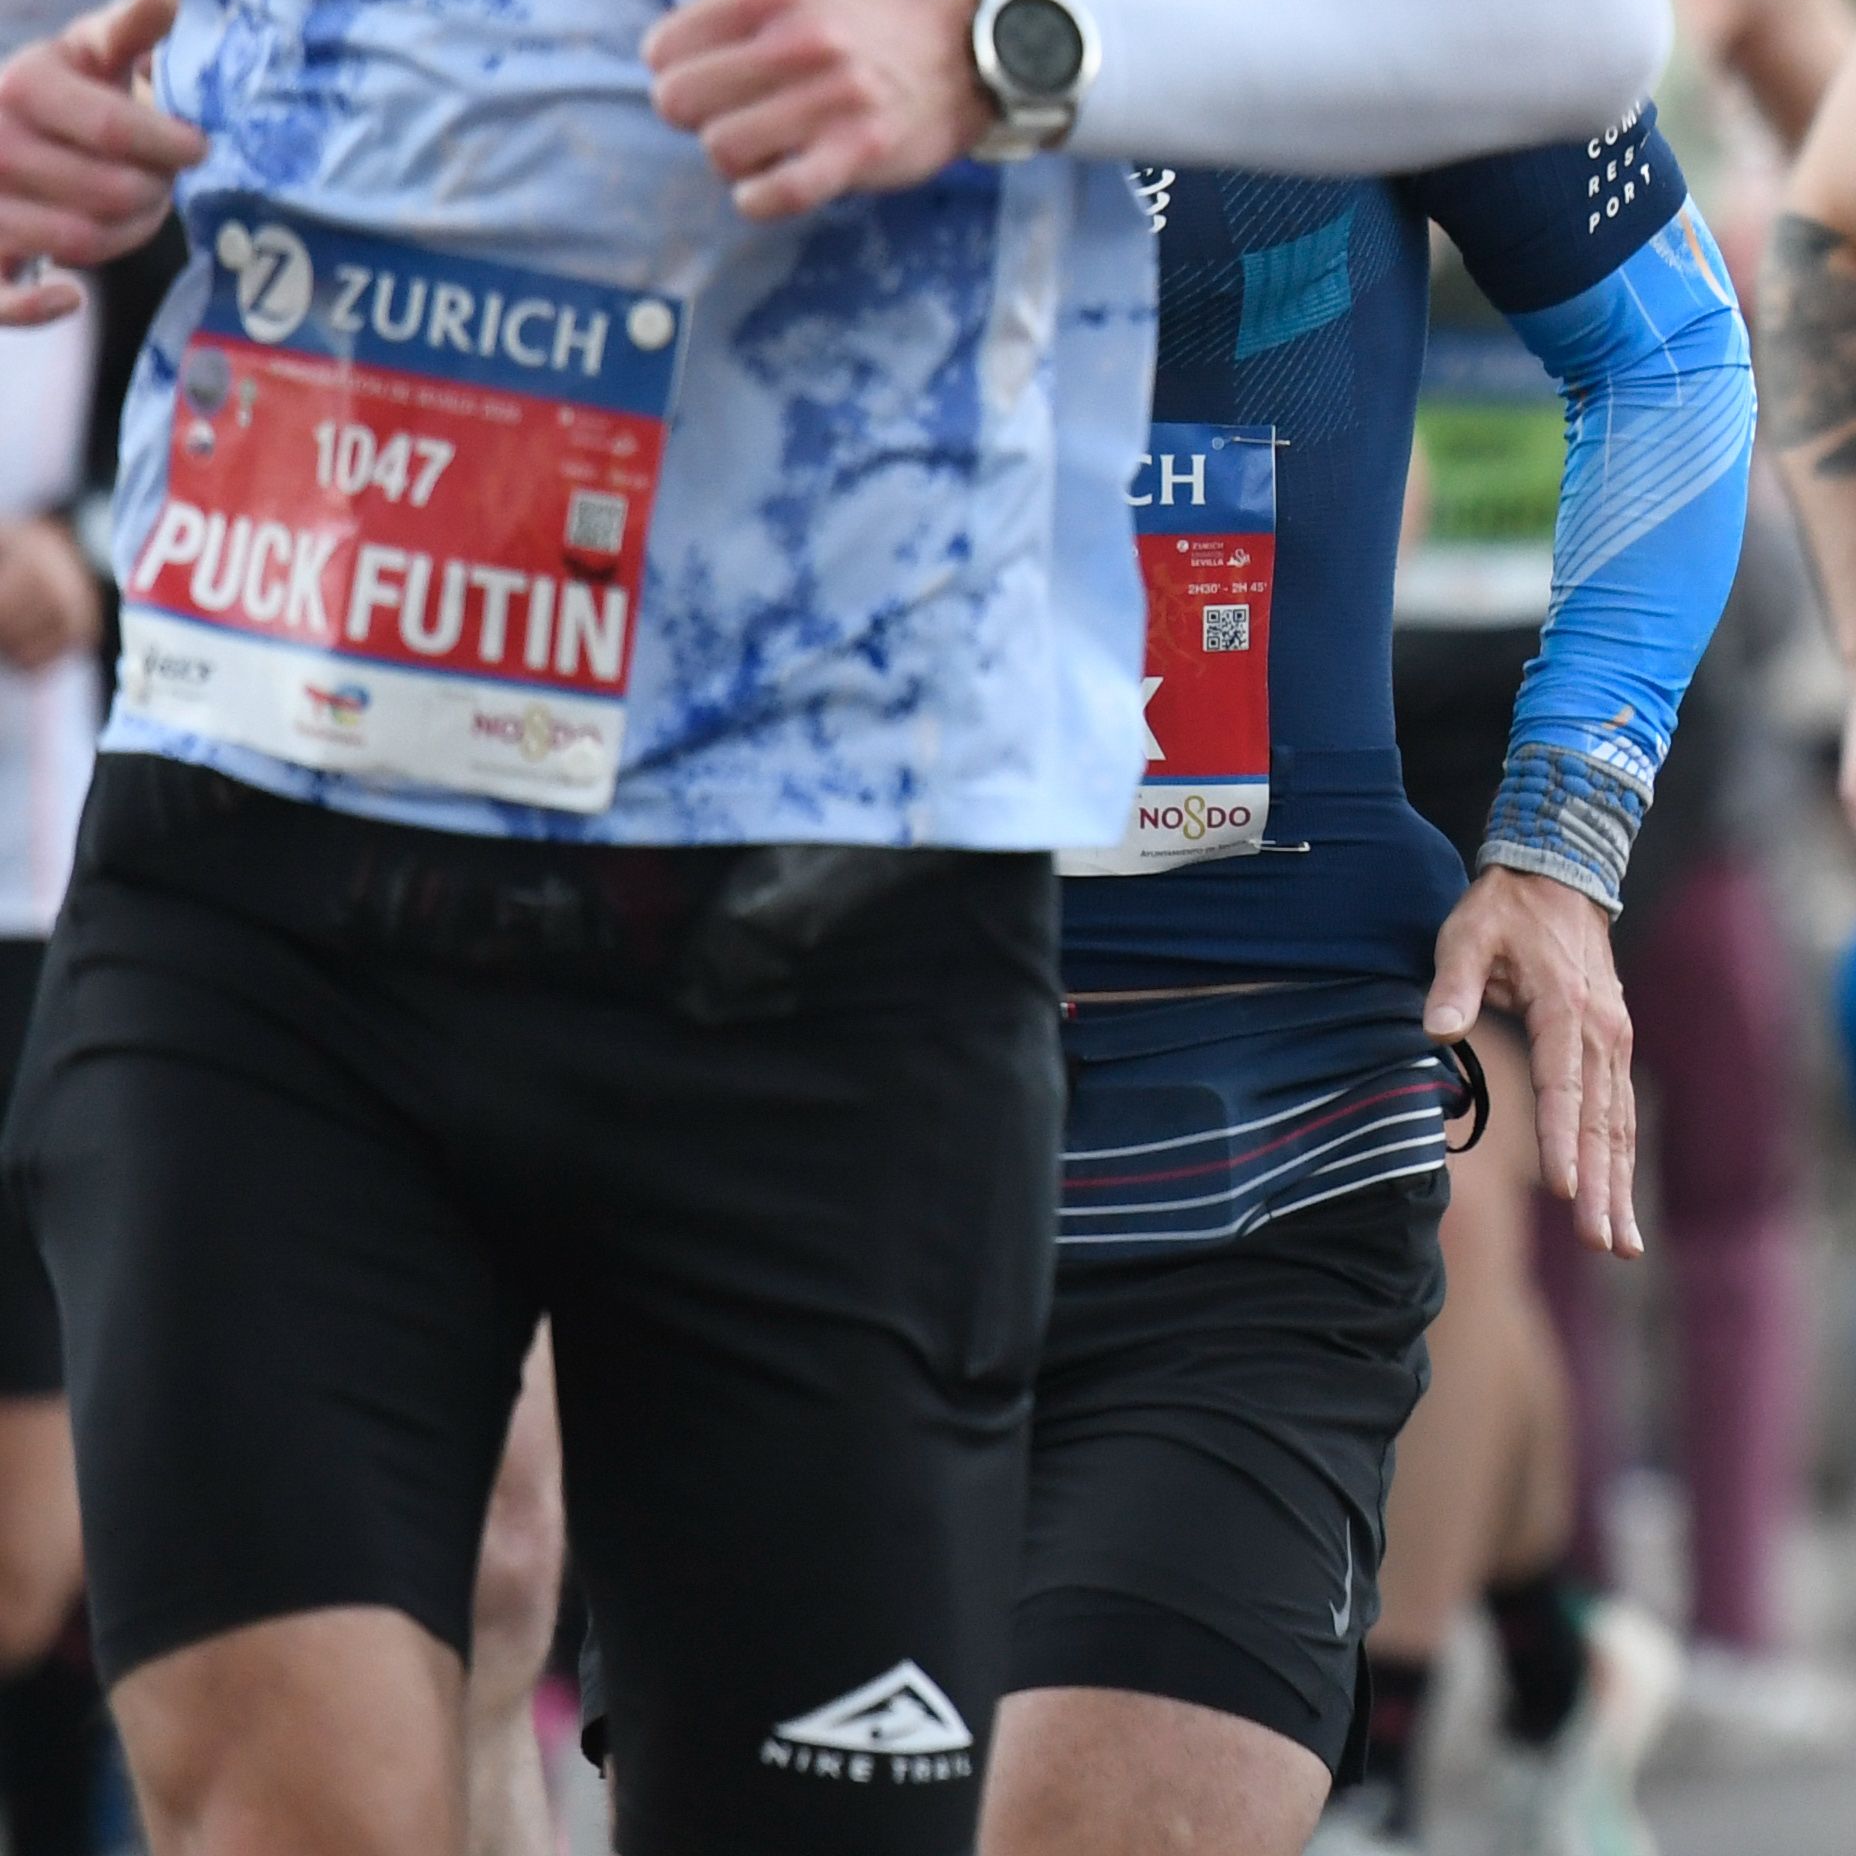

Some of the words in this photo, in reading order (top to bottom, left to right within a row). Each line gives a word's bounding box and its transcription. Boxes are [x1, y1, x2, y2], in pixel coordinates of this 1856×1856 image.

[1588, 163, 1650, 234] PORT
[331, 263, 611, 377] ZURICH
[312, 417, 457, 508] 1047
[134, 500, 340, 632] PUCK
[345, 542, 629, 684] FUTIN
[758, 1737, 875, 1784] NIKE
